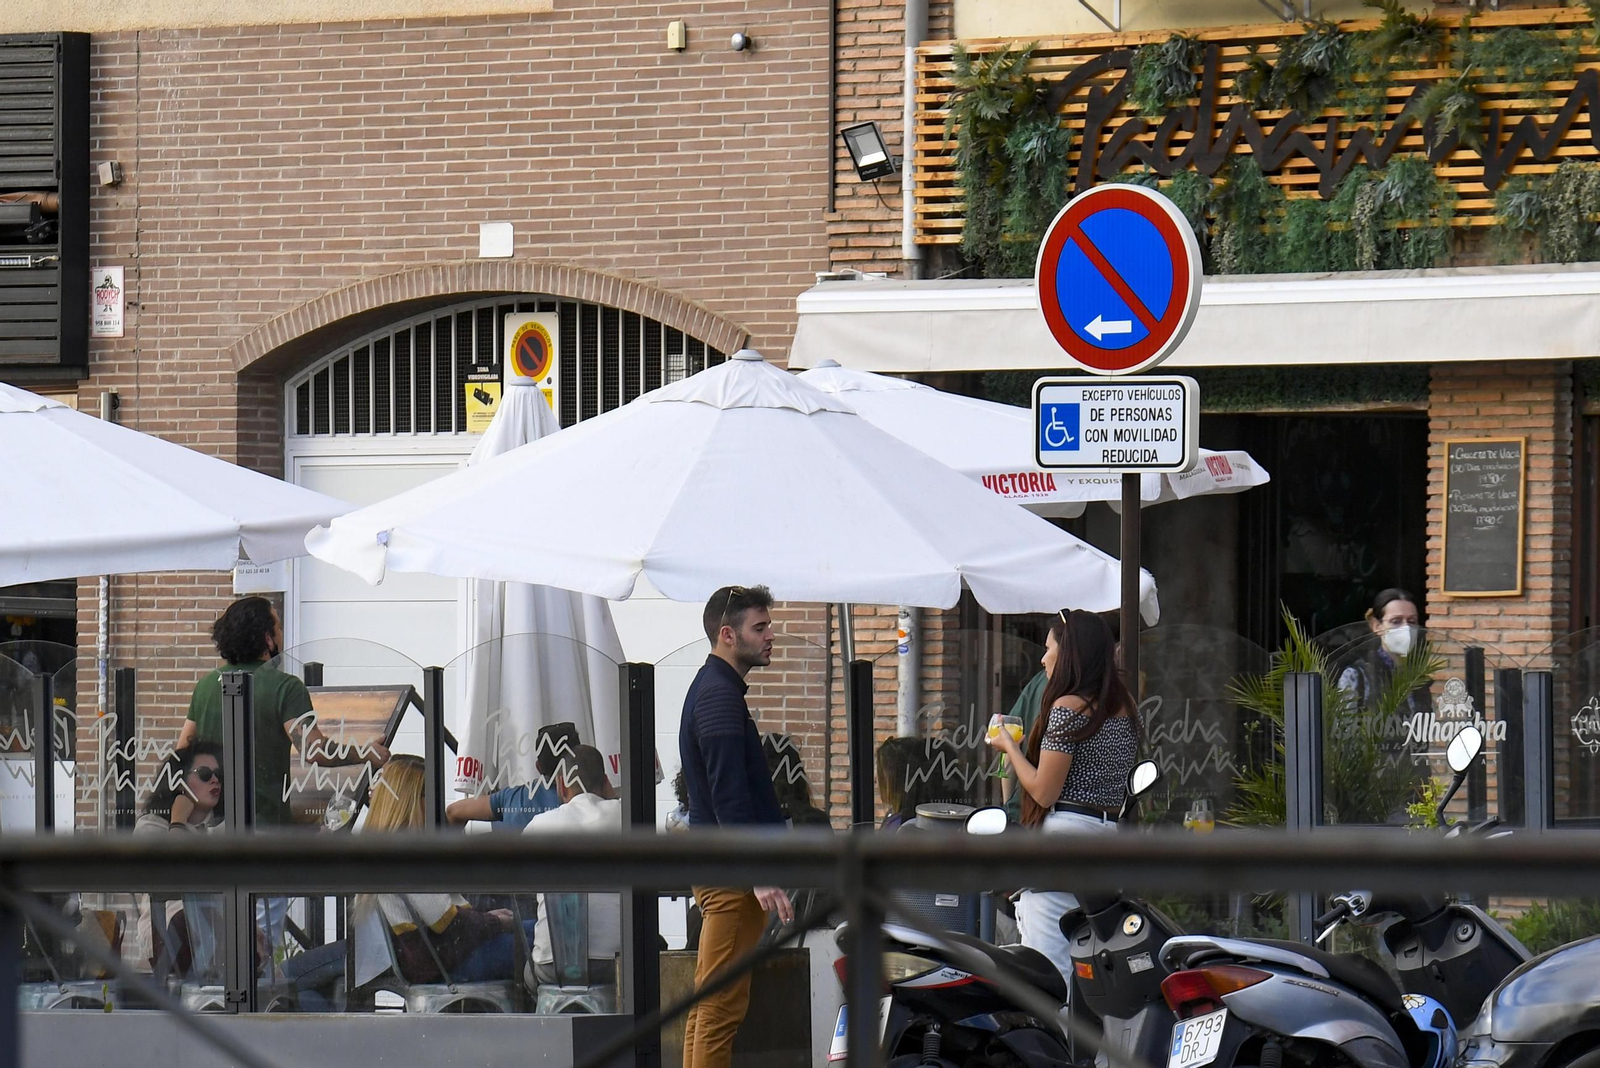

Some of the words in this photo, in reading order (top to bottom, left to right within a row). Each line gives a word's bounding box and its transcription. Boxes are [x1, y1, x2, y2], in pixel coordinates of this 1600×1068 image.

[1082, 389, 1124, 401] EXCEPTO
[1127, 387, 1181, 401] VEHÍCULOS
[1090, 408, 1105, 422] DE
[1110, 407, 1172, 422] PERSONAS
[1085, 428, 1108, 442] CON
[1113, 428, 1177, 442] MOVILIDAD
[1102, 449, 1158, 463] REDUCIDA
[981, 472, 1058, 495] VICTORIA
[1078, 477, 1122, 485] EXQUIS
[914, 701, 989, 760] Pach
[1415, 758, 1497, 766] CERAS
[838, 1024, 844, 1032] E
[1184, 1014, 1223, 1043] 6793
[1175, 1042, 1180, 1050] E
[1180, 1036, 1210, 1064] DRJ
